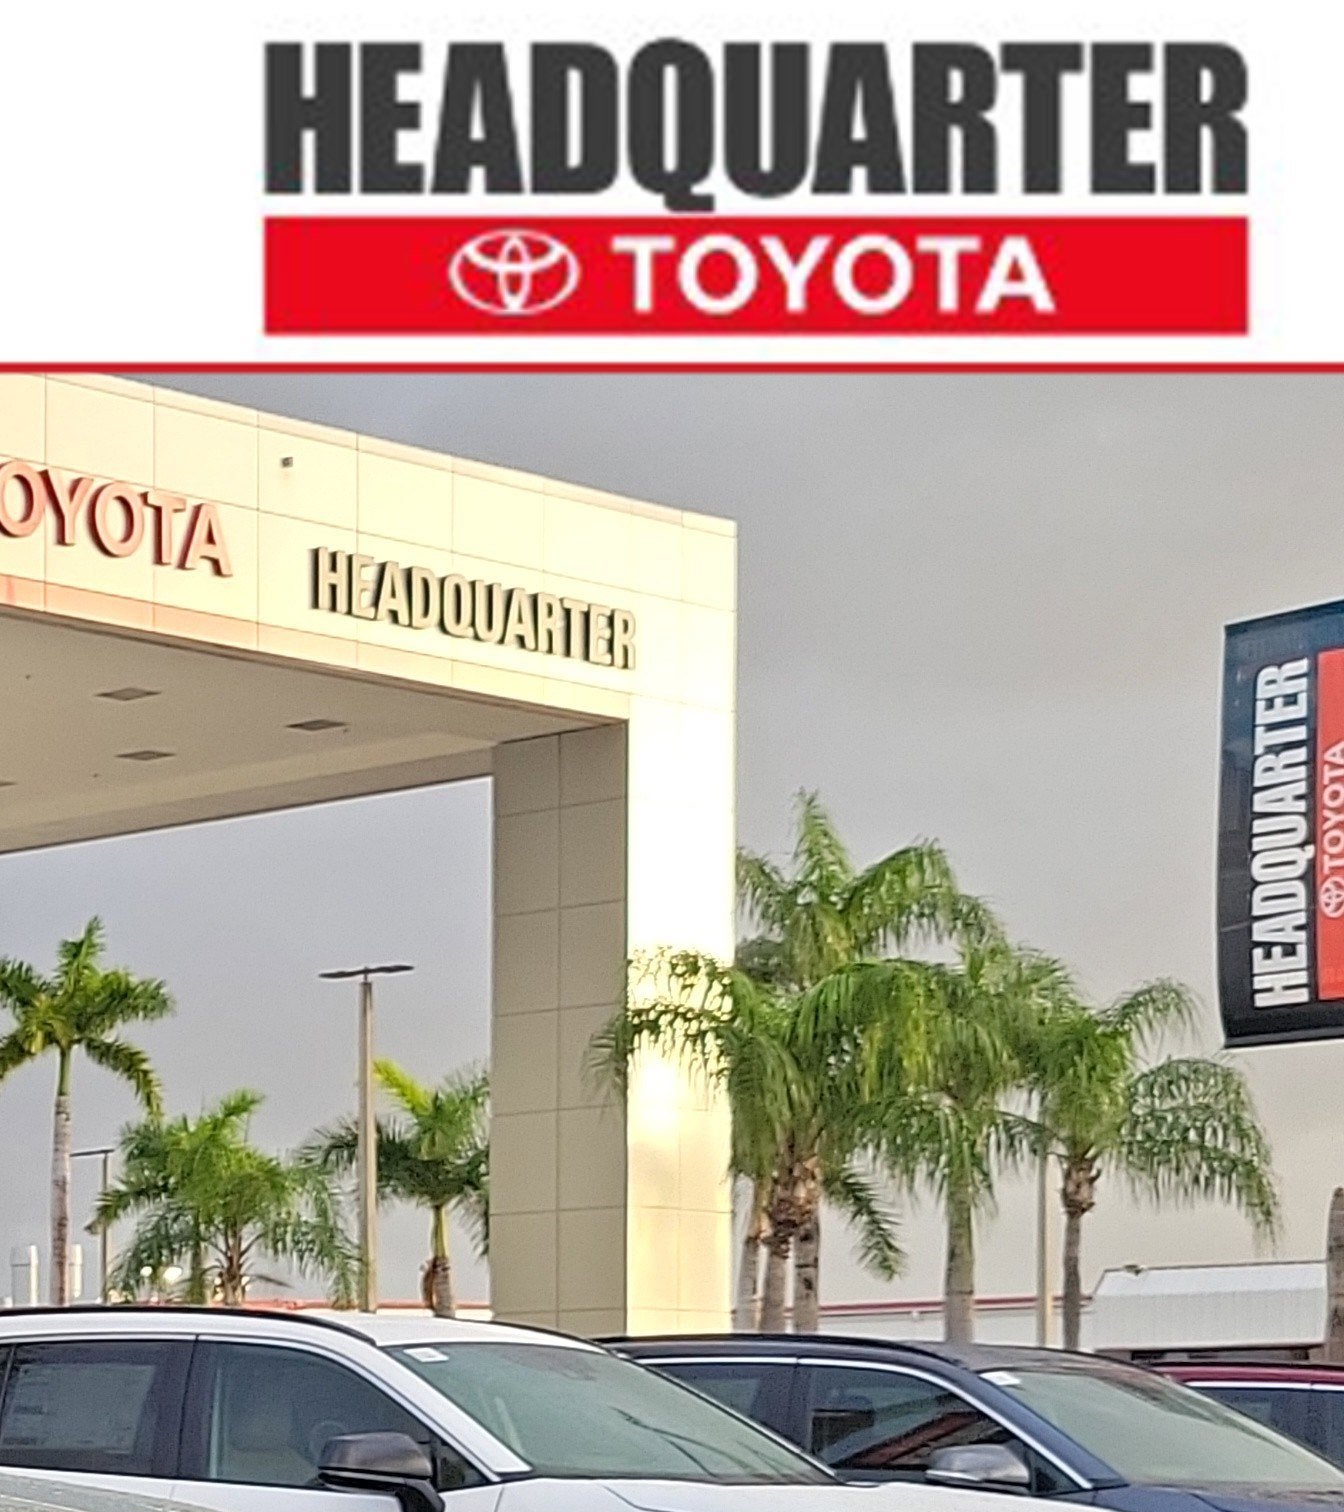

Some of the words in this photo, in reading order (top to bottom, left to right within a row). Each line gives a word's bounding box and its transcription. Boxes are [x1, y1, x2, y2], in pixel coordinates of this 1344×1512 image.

[308, 546, 636, 670] HEADQUARTER
[1250, 656, 1316, 1009] HEADQUARTER
[1322, 741, 1344, 875] TOYOTA
